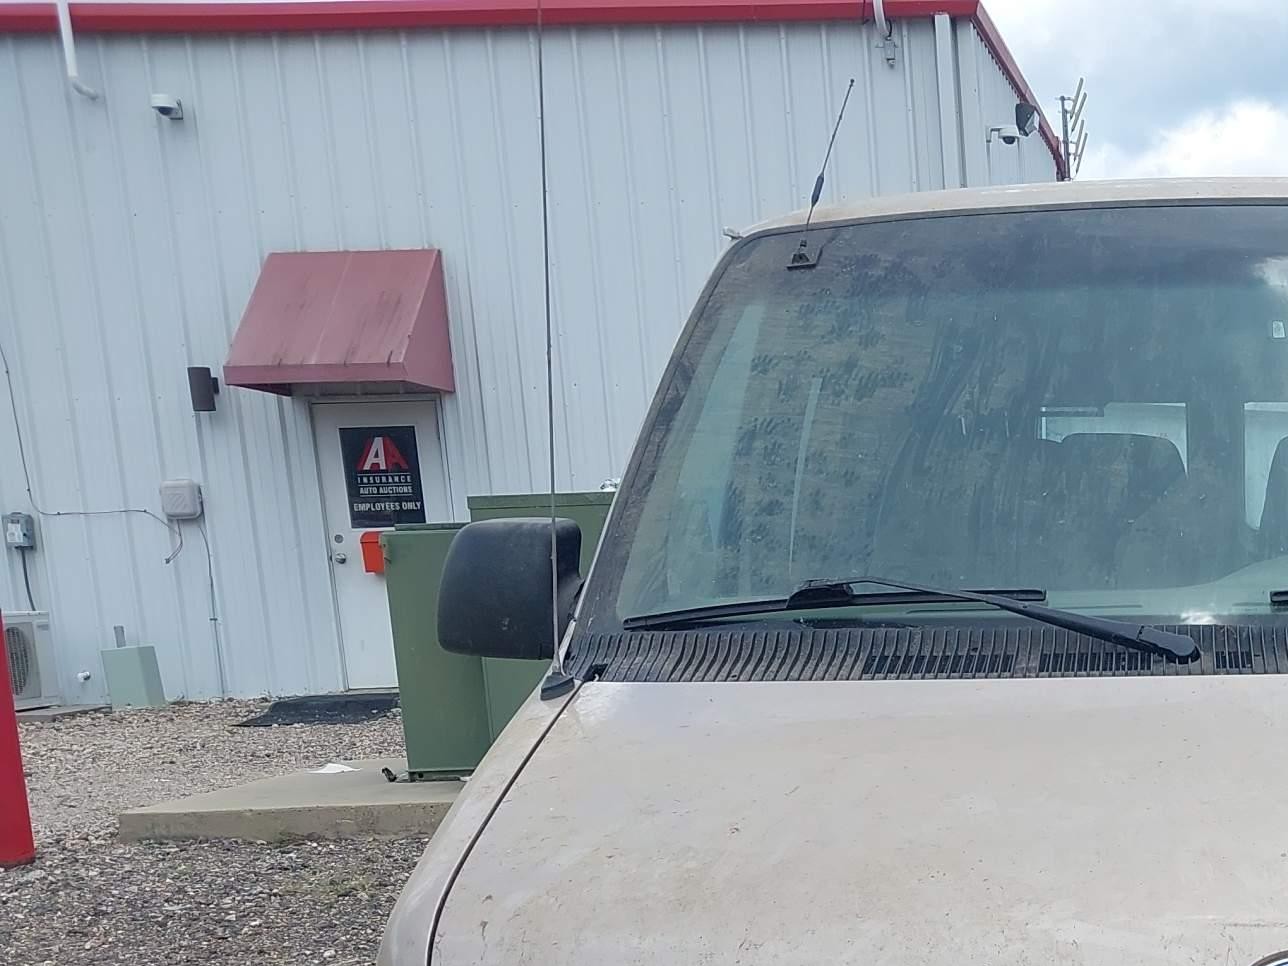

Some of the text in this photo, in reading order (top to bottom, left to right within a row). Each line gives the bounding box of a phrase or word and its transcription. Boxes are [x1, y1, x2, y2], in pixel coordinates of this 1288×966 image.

[357, 475, 412, 484] INSURANCE
[360, 485, 413, 494] AUTO AUCTIONS
[353, 501, 422, 512] EMPLOYEES ONLY
